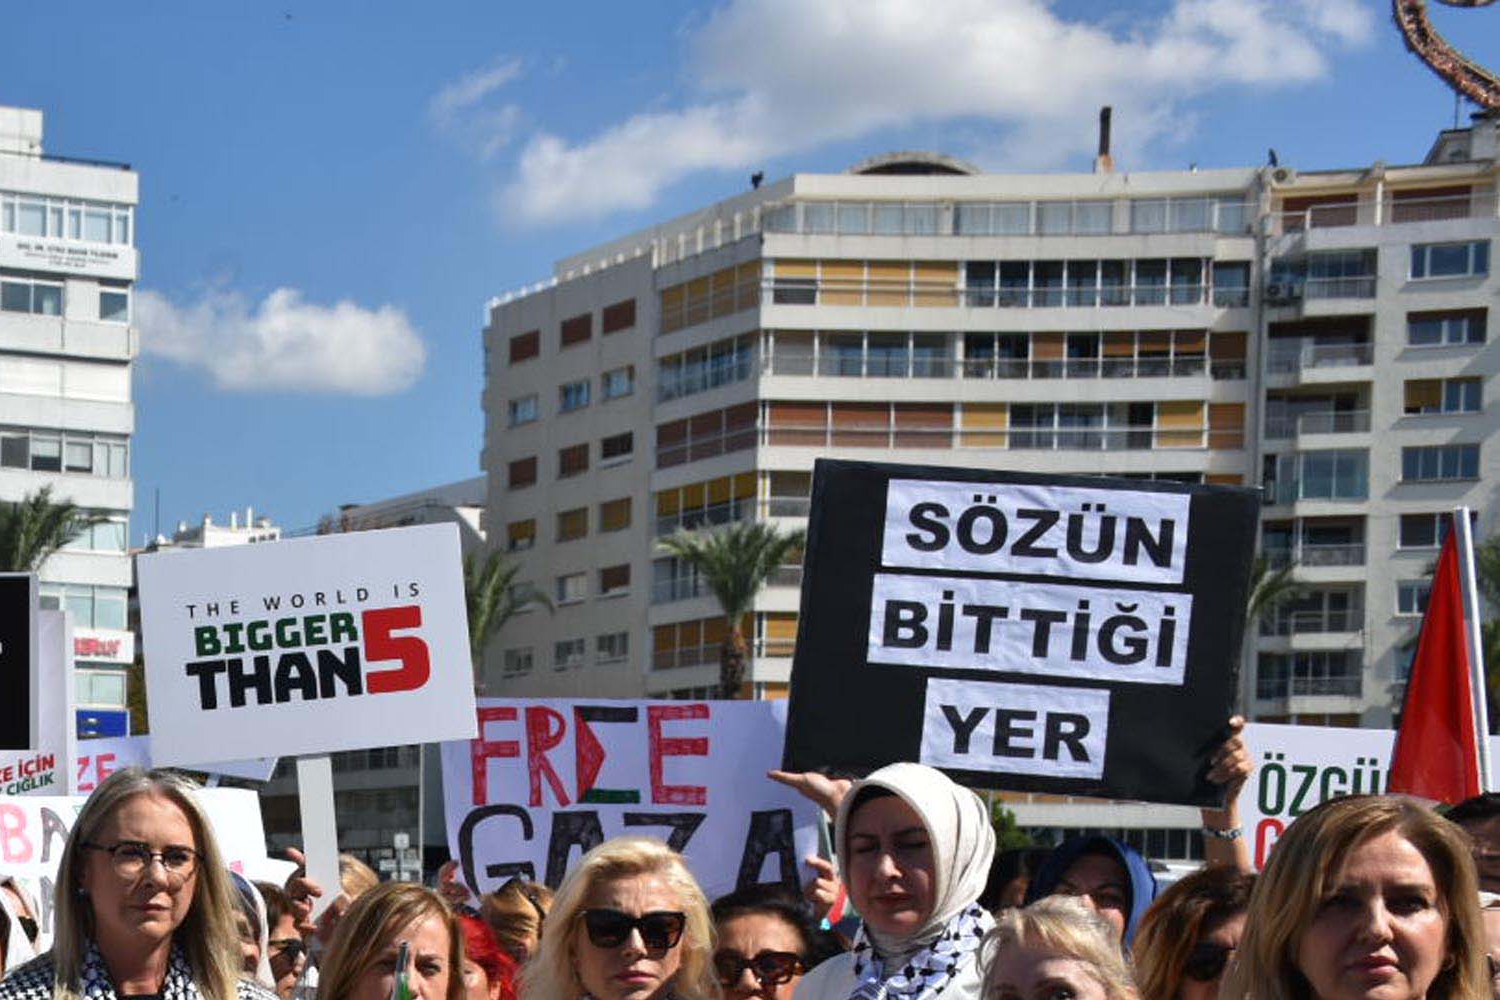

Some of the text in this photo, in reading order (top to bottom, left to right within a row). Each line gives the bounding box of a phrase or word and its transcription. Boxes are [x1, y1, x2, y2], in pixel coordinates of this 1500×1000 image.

[905, 494, 1176, 568] SÖZÜN
[186, 582, 420, 618] THE WORLD IS
[881, 590, 1177, 668] BİTTİĞİ
[185, 605, 431, 710] THAN 5
[194, 612, 359, 657] BIGGER
[939, 704, 1092, 763] YER
[18, 753, 55, 779] İÇİN
